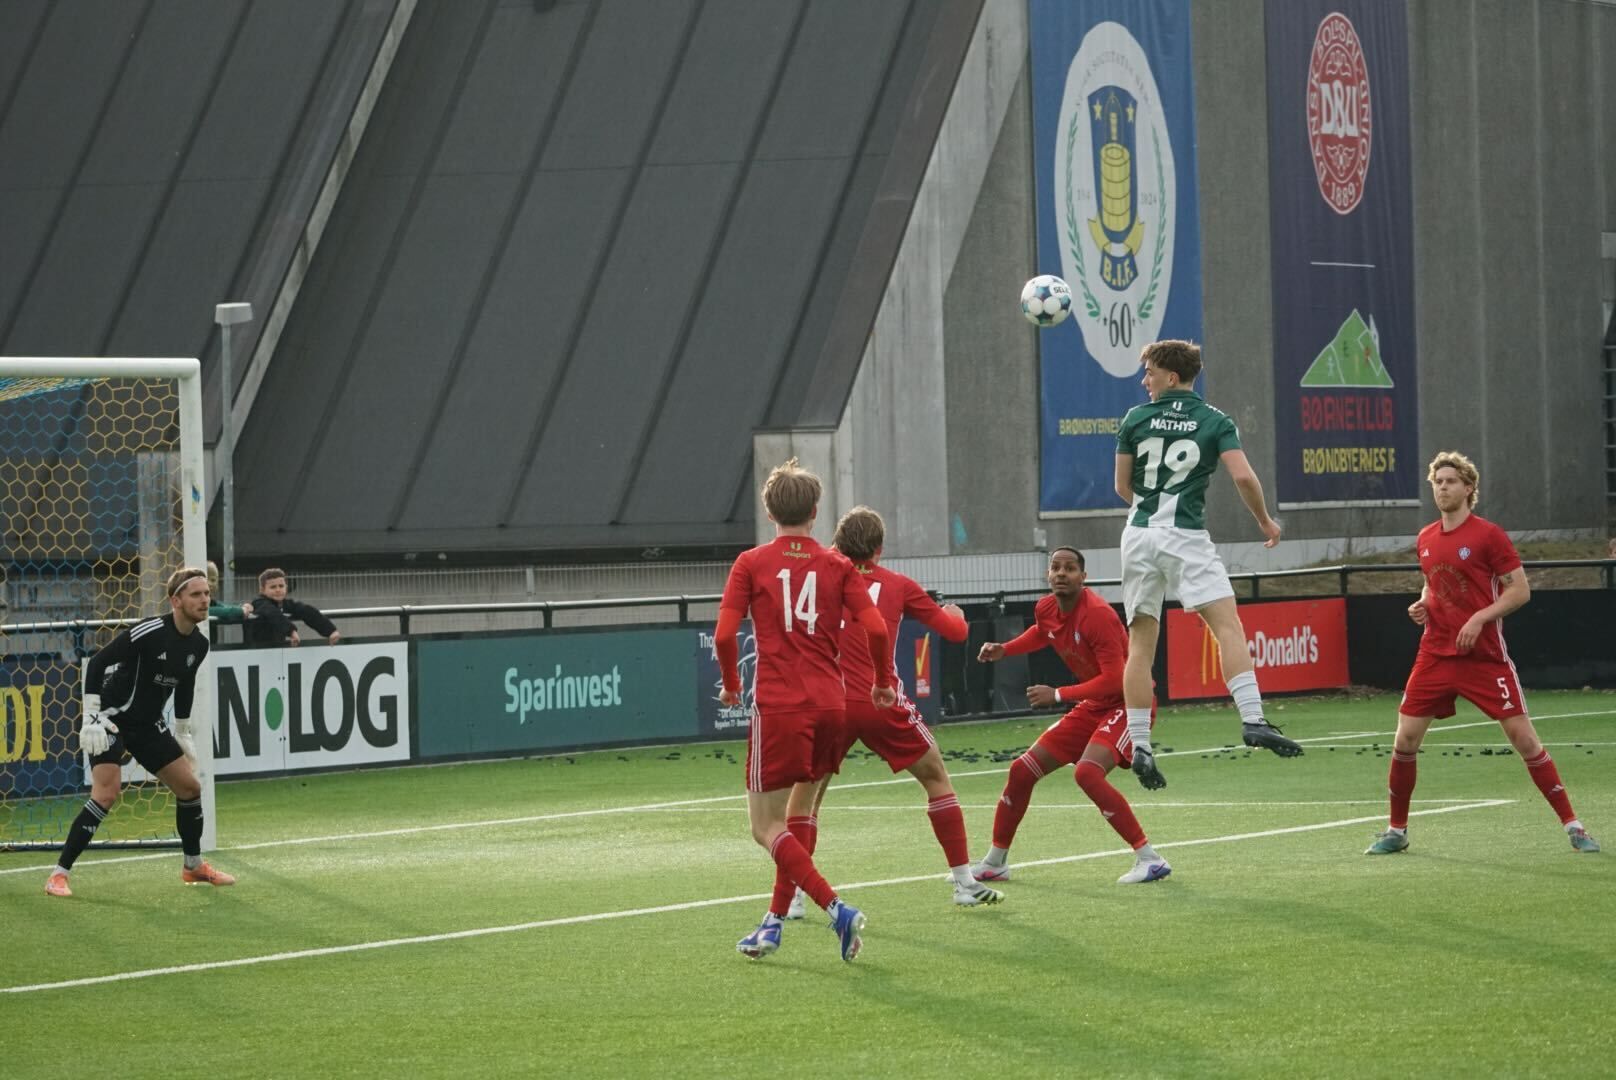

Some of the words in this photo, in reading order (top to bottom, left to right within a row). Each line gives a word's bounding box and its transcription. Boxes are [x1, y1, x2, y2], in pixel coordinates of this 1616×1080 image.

[1320, 79, 1359, 139] DBU
[1331, 182, 1356, 207] 1889
[1150, 418, 1198, 432] MATHYS
[1136, 437, 1200, 490] 19
[1303, 447, 1387, 474] BRØNDBYERNES
[776, 568, 820, 635] 14
[1247, 625, 1319, 669] cDonald's
[504, 664, 622, 725] Sparinvest
[1496, 677, 1510, 700] 5
[1107, 709, 1124, 725] 3
